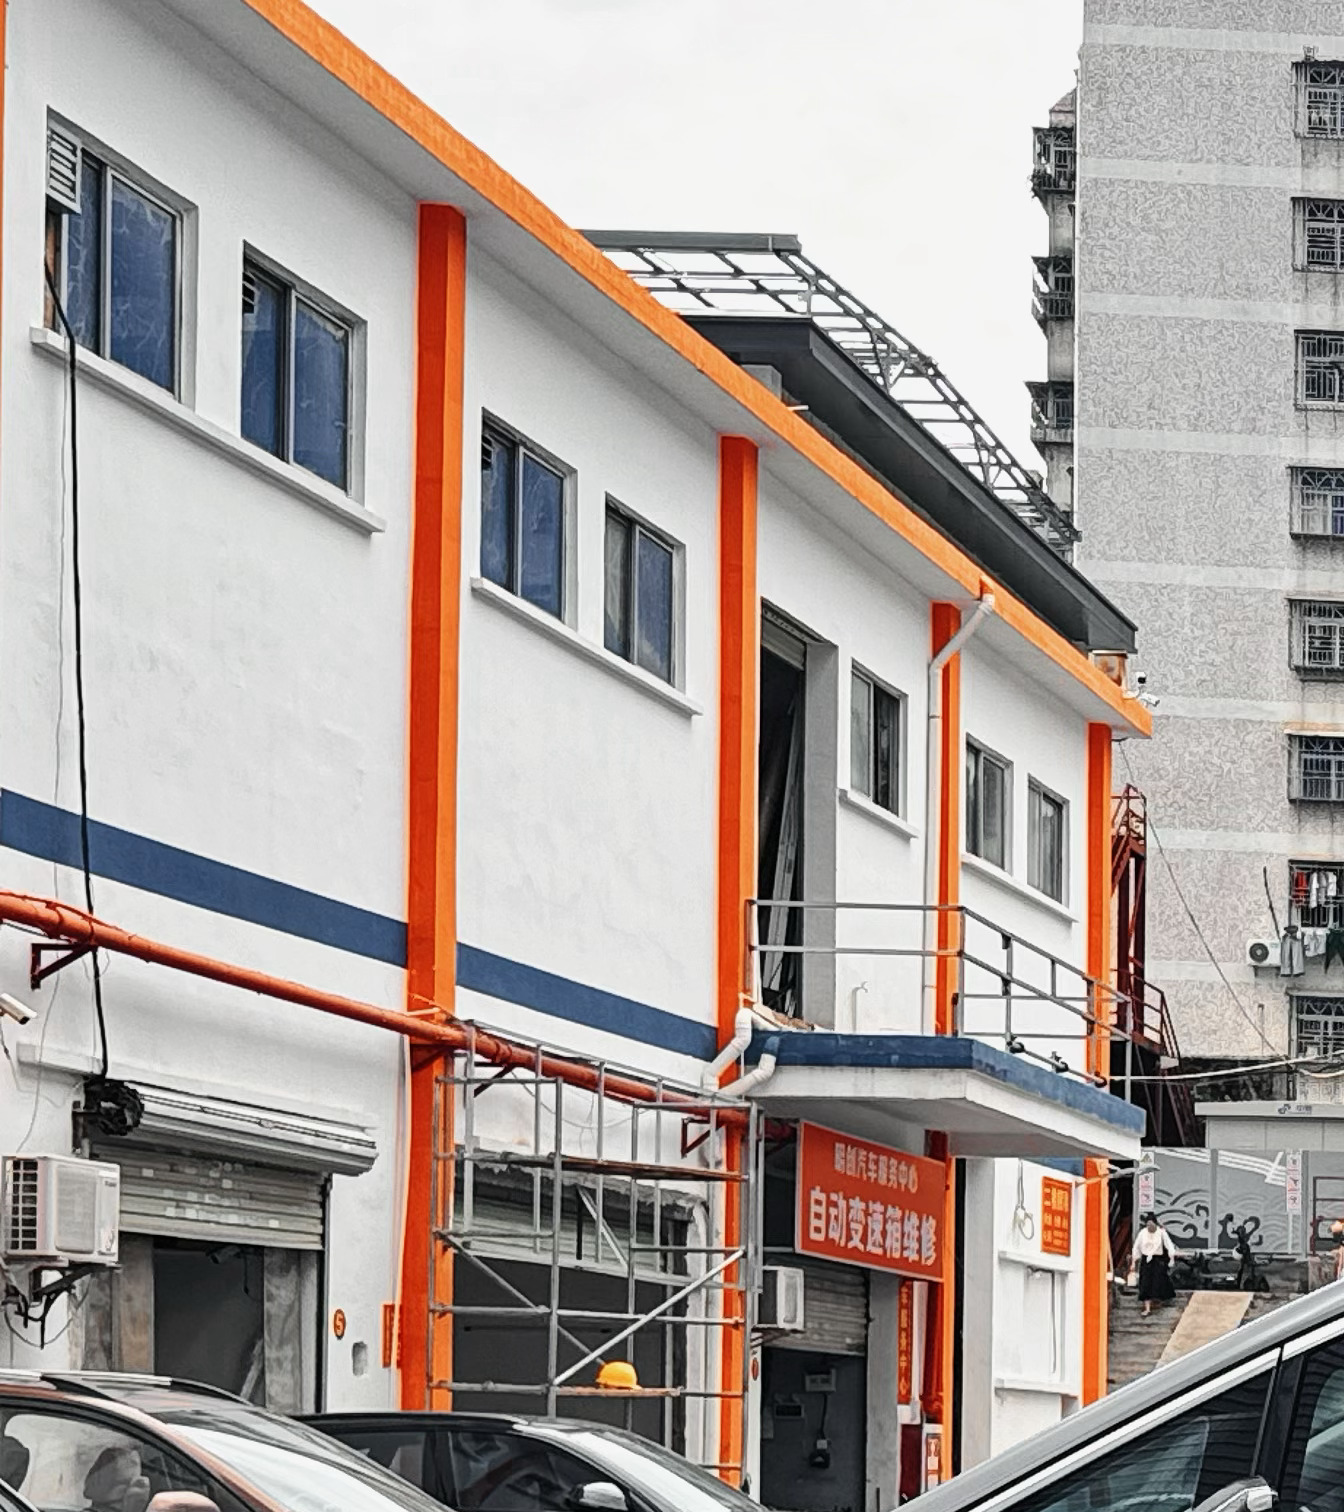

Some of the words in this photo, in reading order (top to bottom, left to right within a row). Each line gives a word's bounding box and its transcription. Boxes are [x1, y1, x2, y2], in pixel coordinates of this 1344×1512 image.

[809, 1185, 937, 1267] 自动变速箱维修
